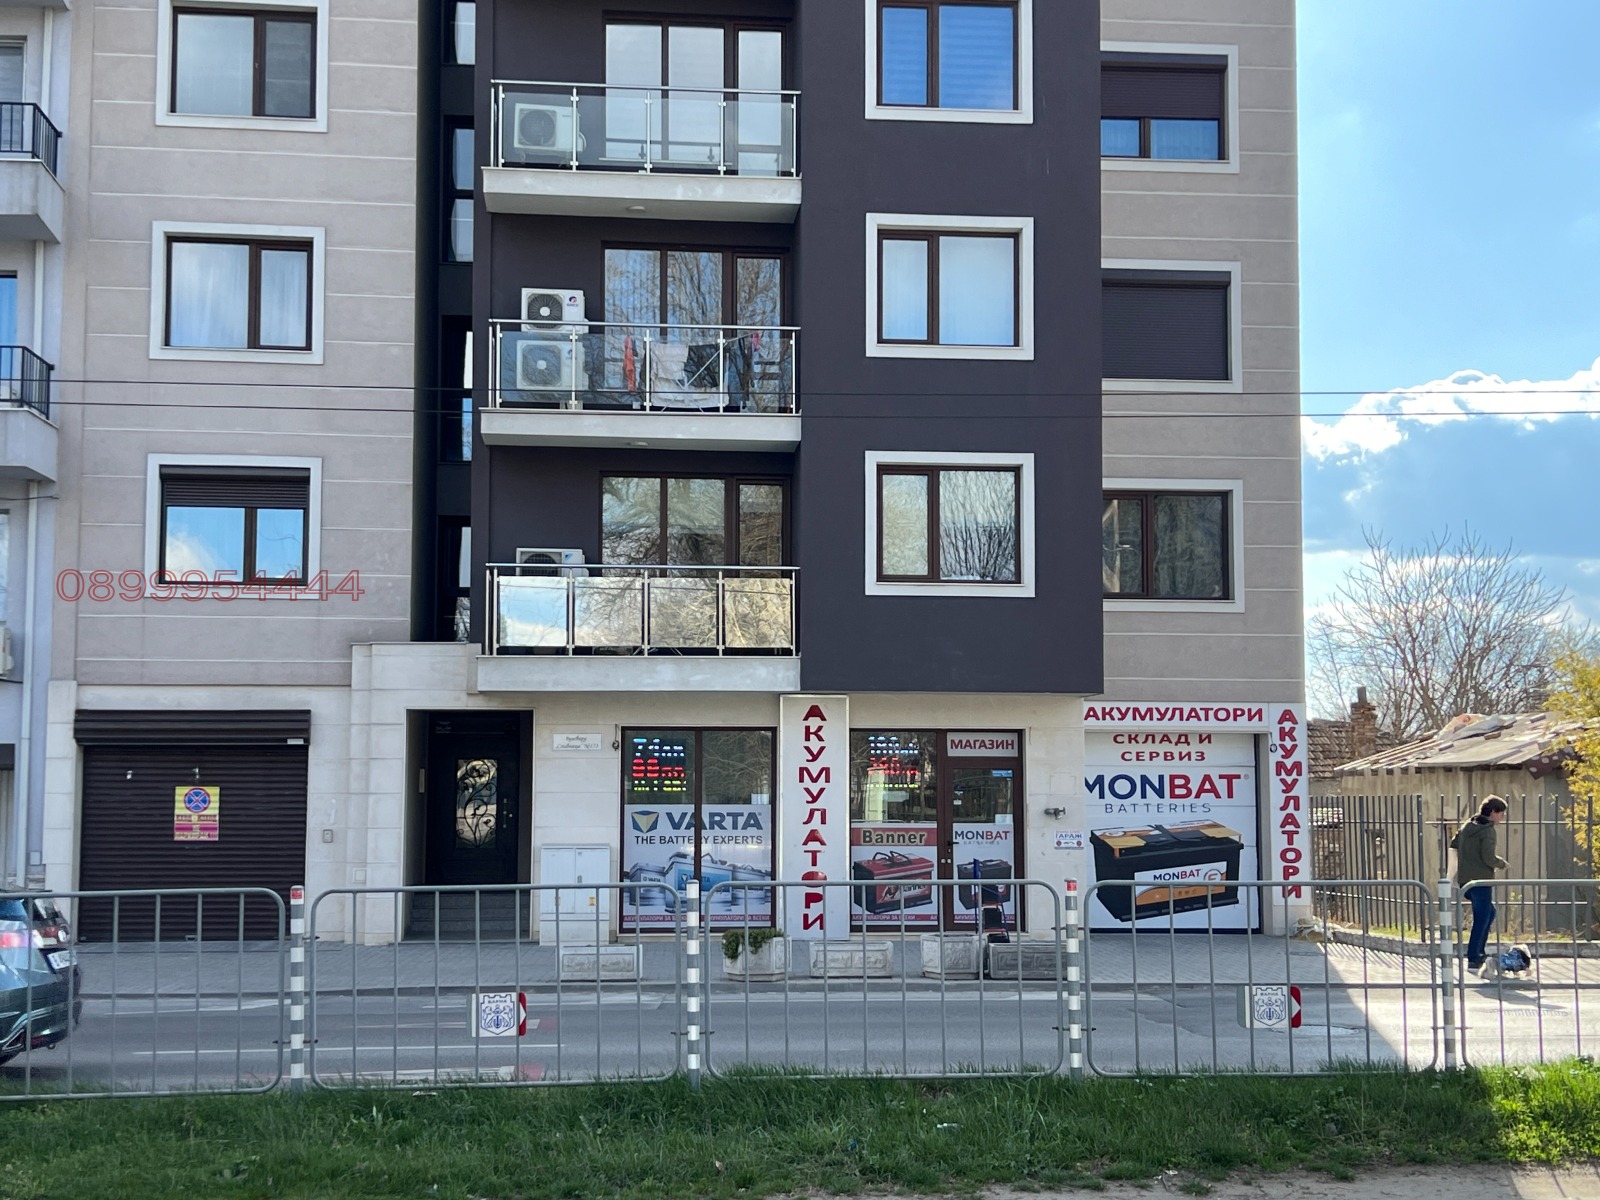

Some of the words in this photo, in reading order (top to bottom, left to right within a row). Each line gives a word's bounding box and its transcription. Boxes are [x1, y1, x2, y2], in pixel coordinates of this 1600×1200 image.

[1084, 706, 1263, 722] АКУМУЛАТОРИ
[950, 738, 1015, 750] МАГАЗИН
[1112, 733, 1191, 746] СКЛАД
[1198, 734, 1212, 744] И
[1120, 751, 1206, 761] СЕРВИЗ
[1084, 773, 1241, 800] MONBAT
[1104, 803, 1211, 813] BATTERIES
[1275, 709, 1303, 899] АКУМУЛАТОРИ
[665, 812, 763, 830] VARTA
[798, 704, 831, 931] АКУМУЛАТОРИ
[634, 835, 656, 845] THE
[658, 835, 711, 845] BATTEY
[713, 835, 763, 845] EXPERTS
[862, 829, 926, 844] Banner
[954, 830, 1011, 841] MONBAT
[1153, 869, 1201, 881] MONBAT
